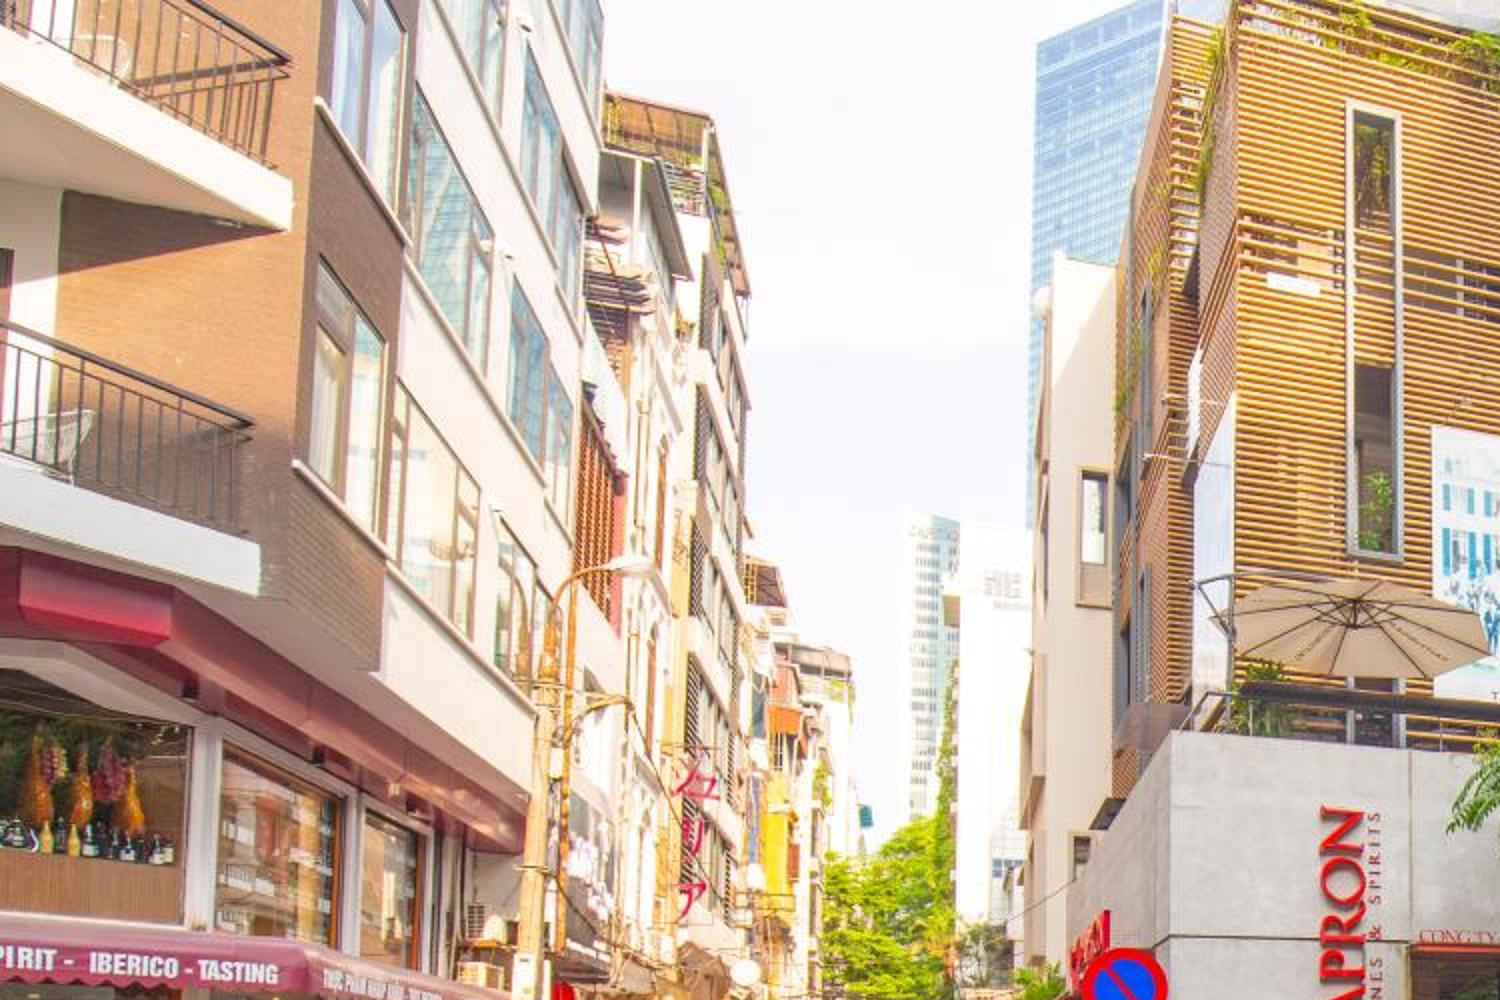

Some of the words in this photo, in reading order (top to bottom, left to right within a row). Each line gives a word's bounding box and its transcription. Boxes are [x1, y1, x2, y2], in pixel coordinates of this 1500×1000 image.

[1366, 811, 1382, 905] SPIRITS
[1366, 923, 1383, 942] &
[89, 951, 179, 979] IBERICO
[198, 959, 279, 984] TASTING
